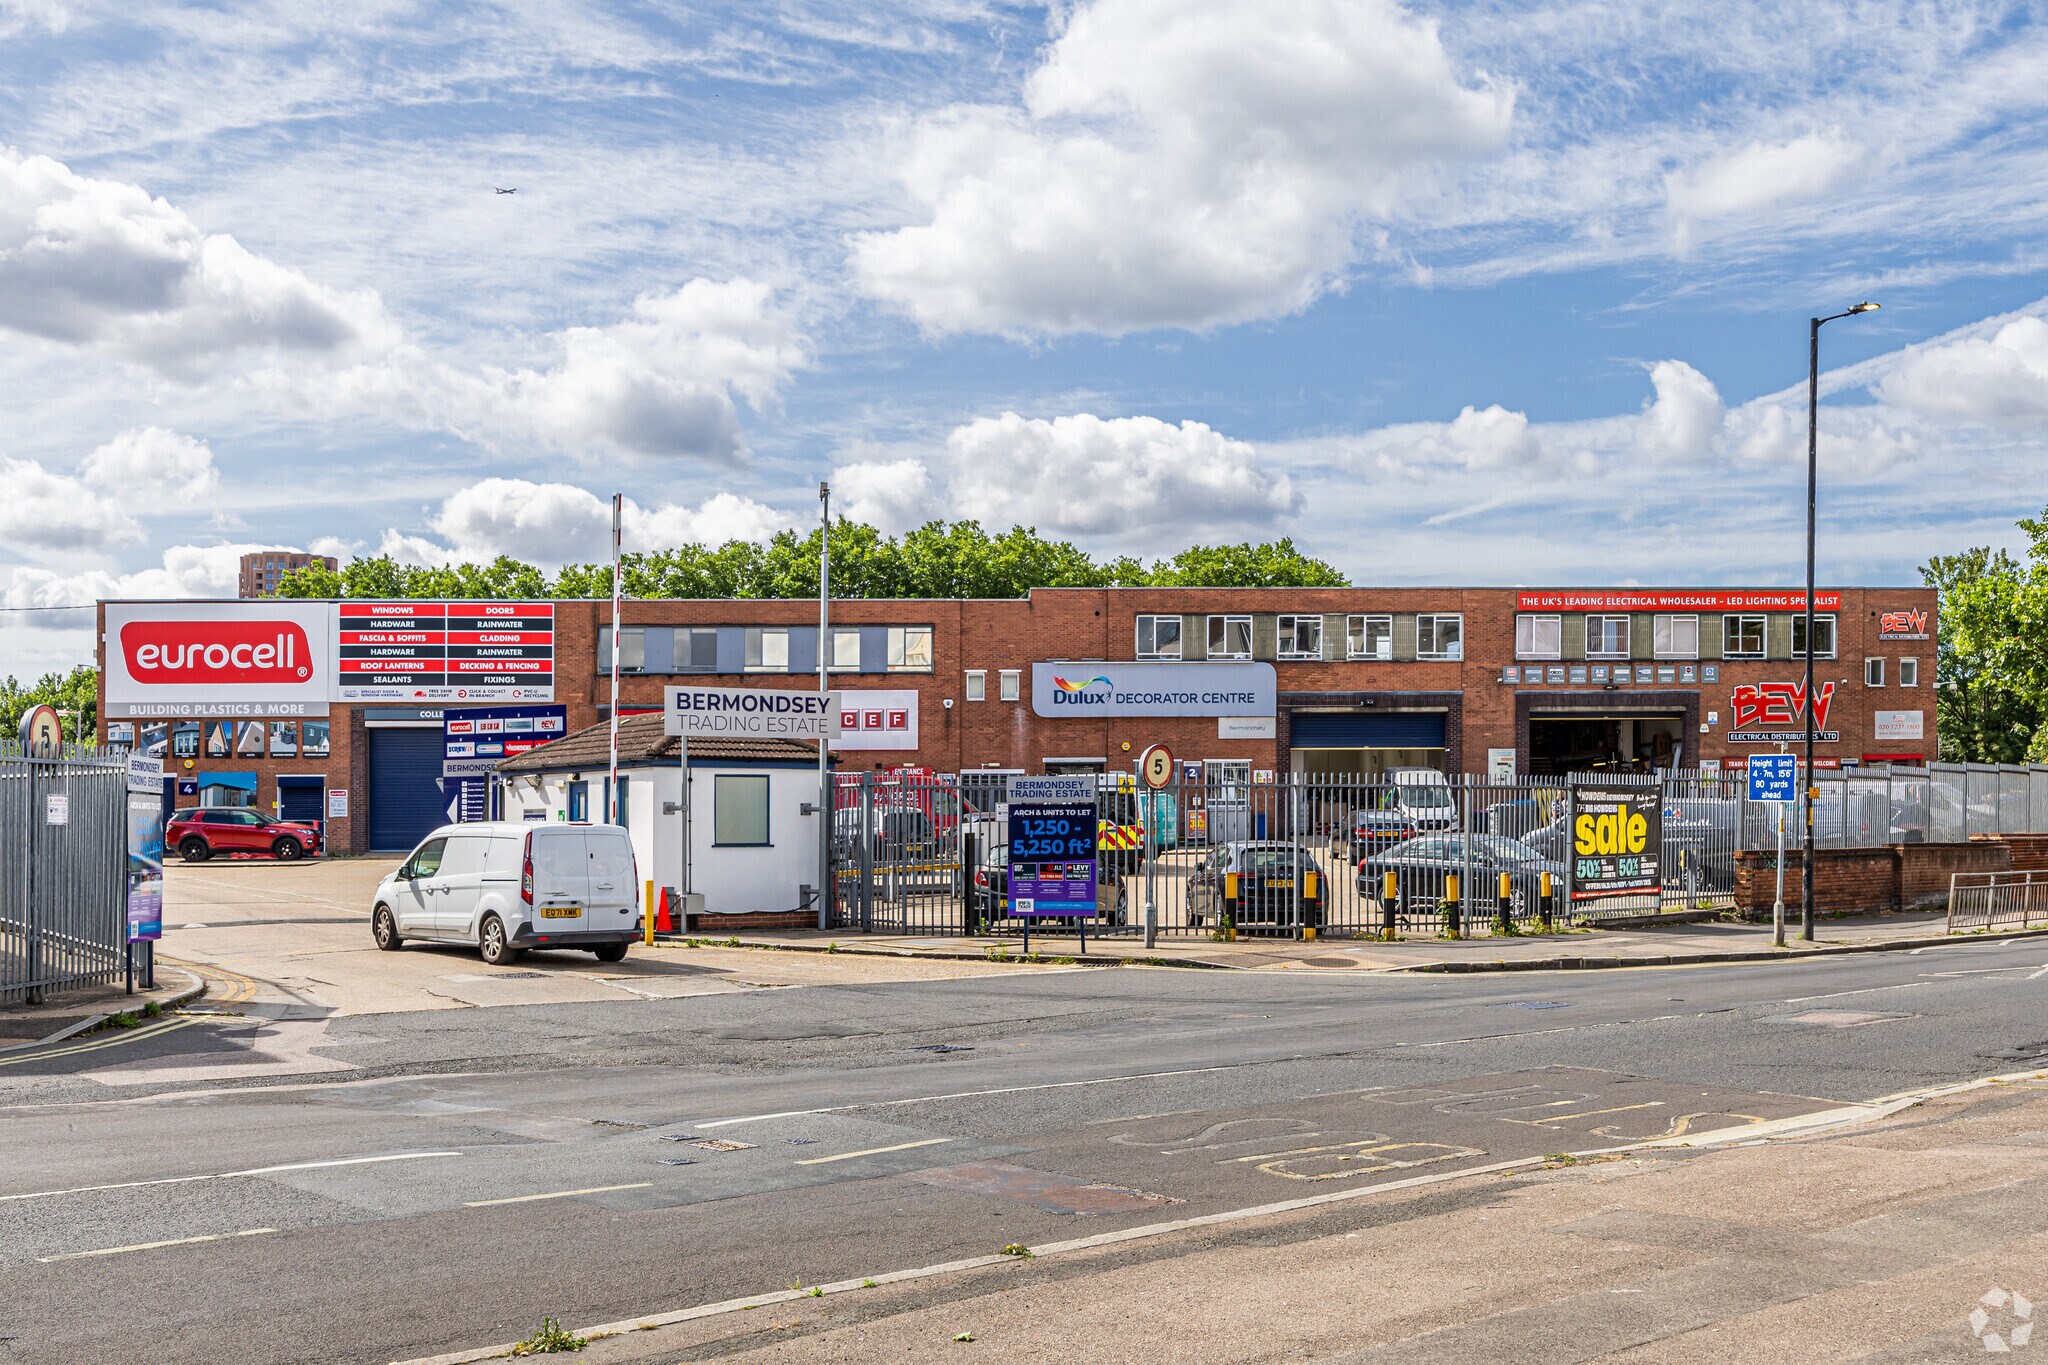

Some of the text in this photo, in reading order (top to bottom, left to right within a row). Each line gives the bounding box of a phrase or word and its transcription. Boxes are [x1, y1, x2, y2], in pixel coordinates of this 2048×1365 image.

[1522, 597, 1539, 606] THE
[1542, 597, 1562, 606] UK'S
[1566, 597, 1603, 606] LEADING
[1606, 597, 1657, 606] ELECTRICAL
[1660, 597, 1716, 605] WHOLESALER
[1727, 597, 1743, 605] LED
[1746, 596, 1787, 605] LIGHTING
[1881, 606, 1927, 634] BEW
[137, 634, 293, 669] eurocell
[676, 692, 830, 714] BERMONDSEY
[1053, 690, 1255, 705] Dulux DECORATOR CENTRE
[129, 704, 304, 715] BUILDING PLASTICS & MORE
[1731, 674, 1835, 737] BEW
[677, 714, 828, 733] TRADING ESTATE
[42, 725, 50, 749] 5
[131, 760, 160, 774] BERMONDSEY
[1154, 759, 1163, 775] 5
[1752, 760, 1772, 768] Height
[1189, 769, 1196, 777] 2
[128, 774, 163, 789] TRADING ESTATE
[1016, 781, 1084, 789] BERMONDSEY
[1770, 780, 1788, 789] yards
[184, 785, 192, 794] 4
[1582, 791, 1606, 801] HOWDENS
[134, 816, 152, 837] 1,250
[1023, 820, 1069, 838] 1,250
[1575, 805, 1647, 856] sale
[1013, 840, 1064, 857] 5,250
